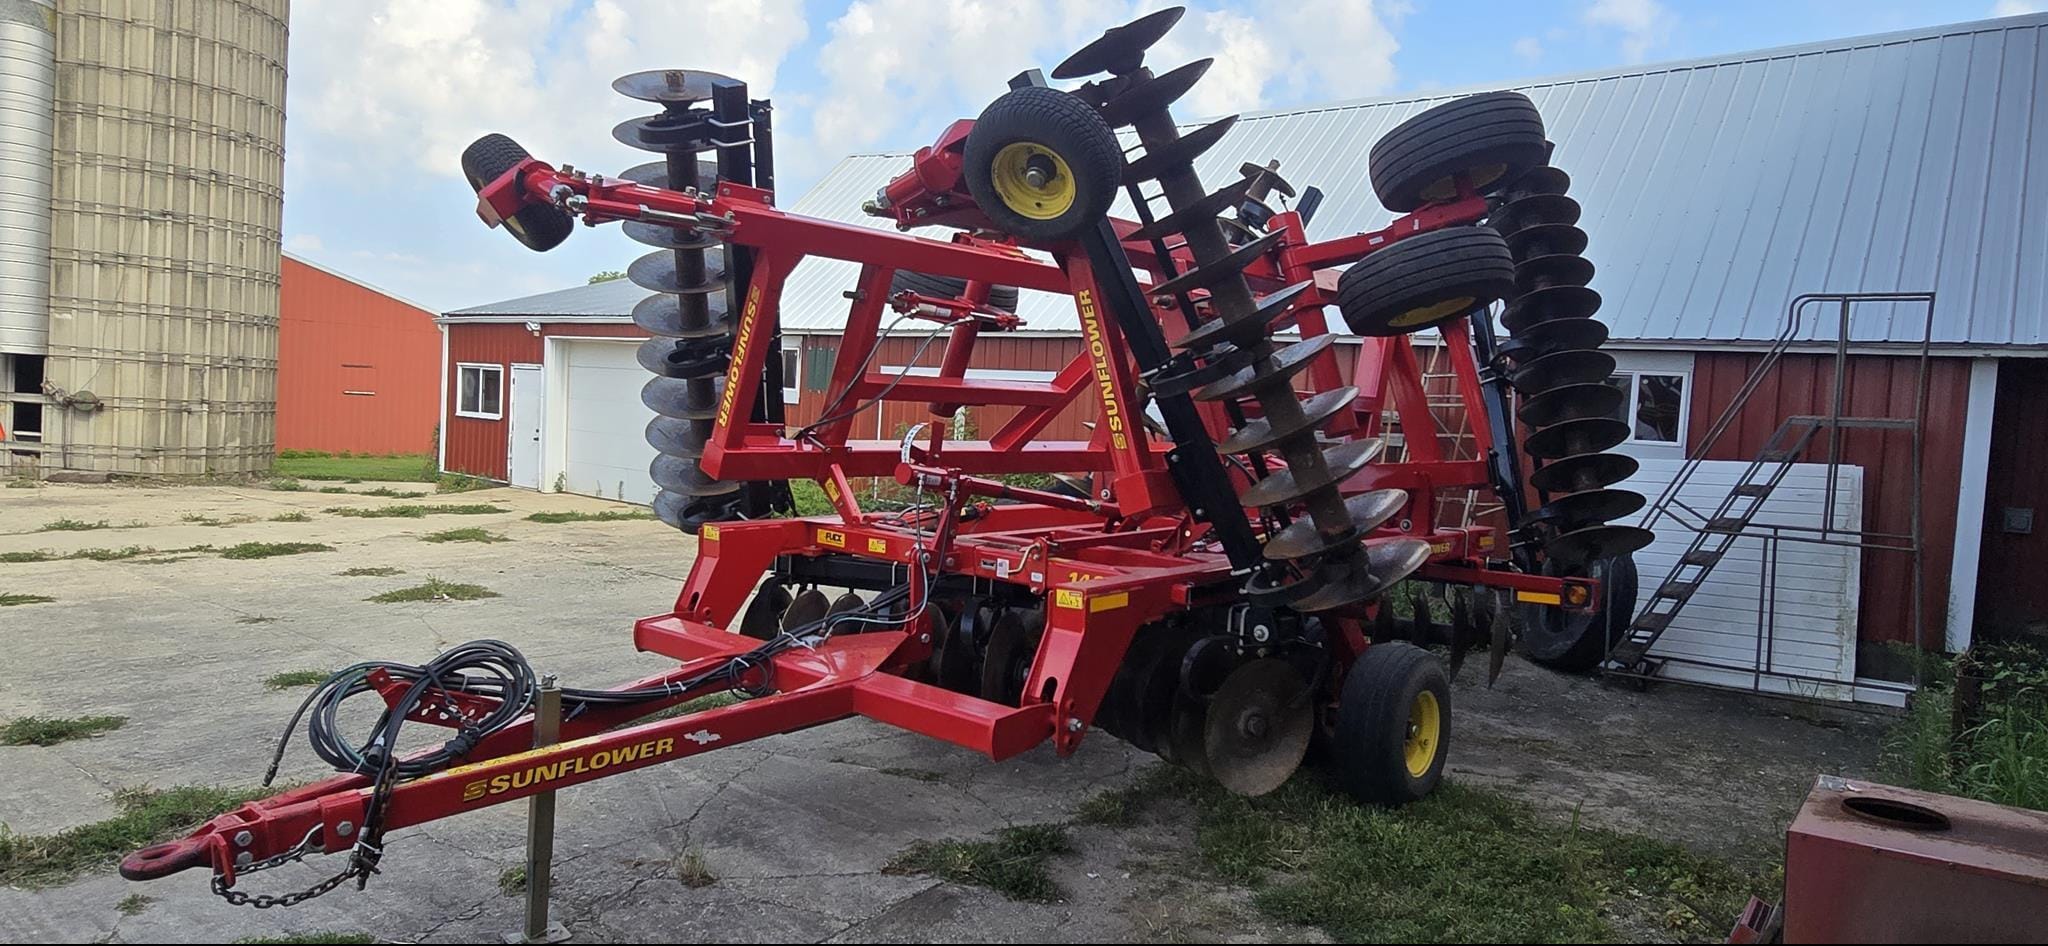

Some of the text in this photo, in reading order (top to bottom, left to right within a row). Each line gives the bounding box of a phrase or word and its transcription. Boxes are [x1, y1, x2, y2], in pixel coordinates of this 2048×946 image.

[718, 301, 757, 427] SUNFLOWER
[1079, 288, 1123, 432] SUNFLOWER
[1069, 572, 1104, 583] 14
[490, 737, 674, 794] SUNFLOWER
